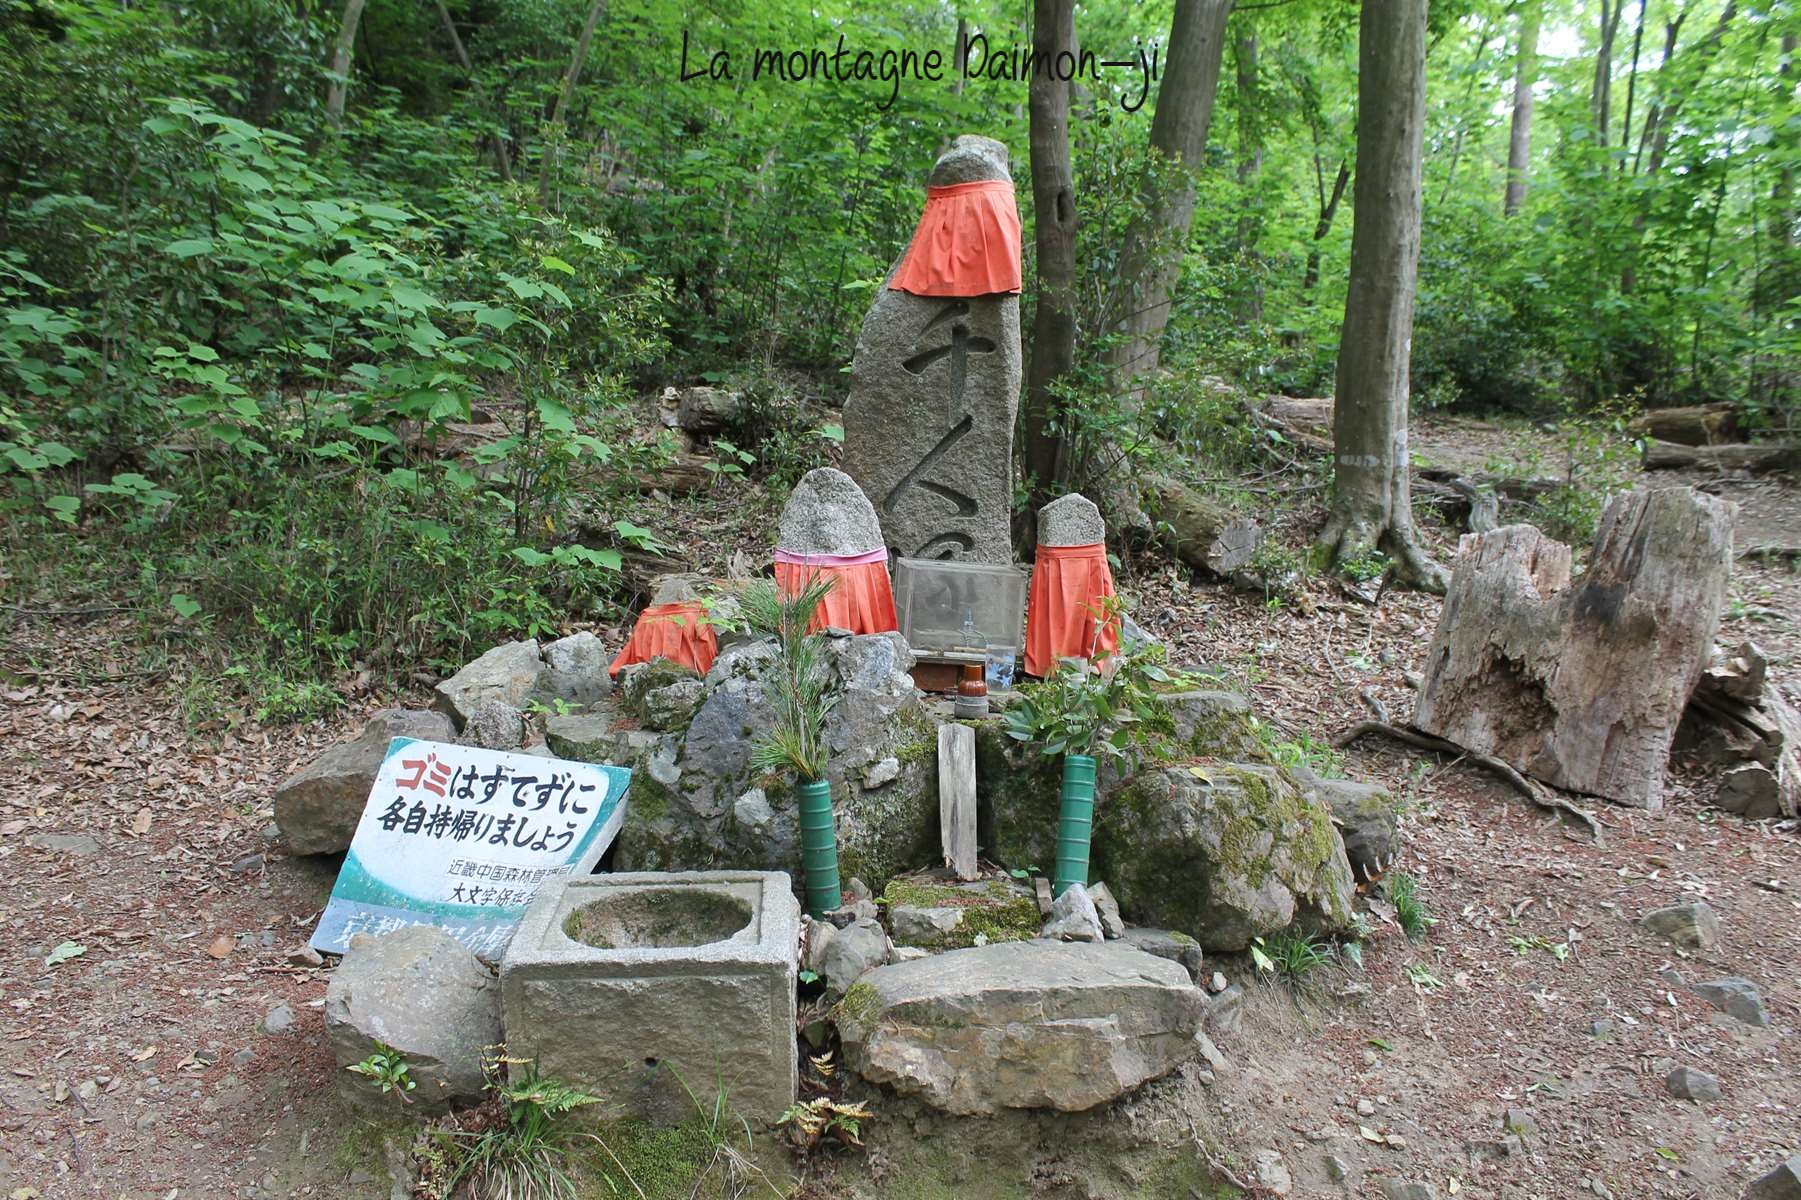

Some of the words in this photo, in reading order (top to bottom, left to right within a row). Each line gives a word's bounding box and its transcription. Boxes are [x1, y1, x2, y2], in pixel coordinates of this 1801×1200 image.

[884, 302, 997, 560] 千人
[395, 753, 597, 815] ゴミはすてずに
[376, 796, 579, 854] 各自持帰りましょう
